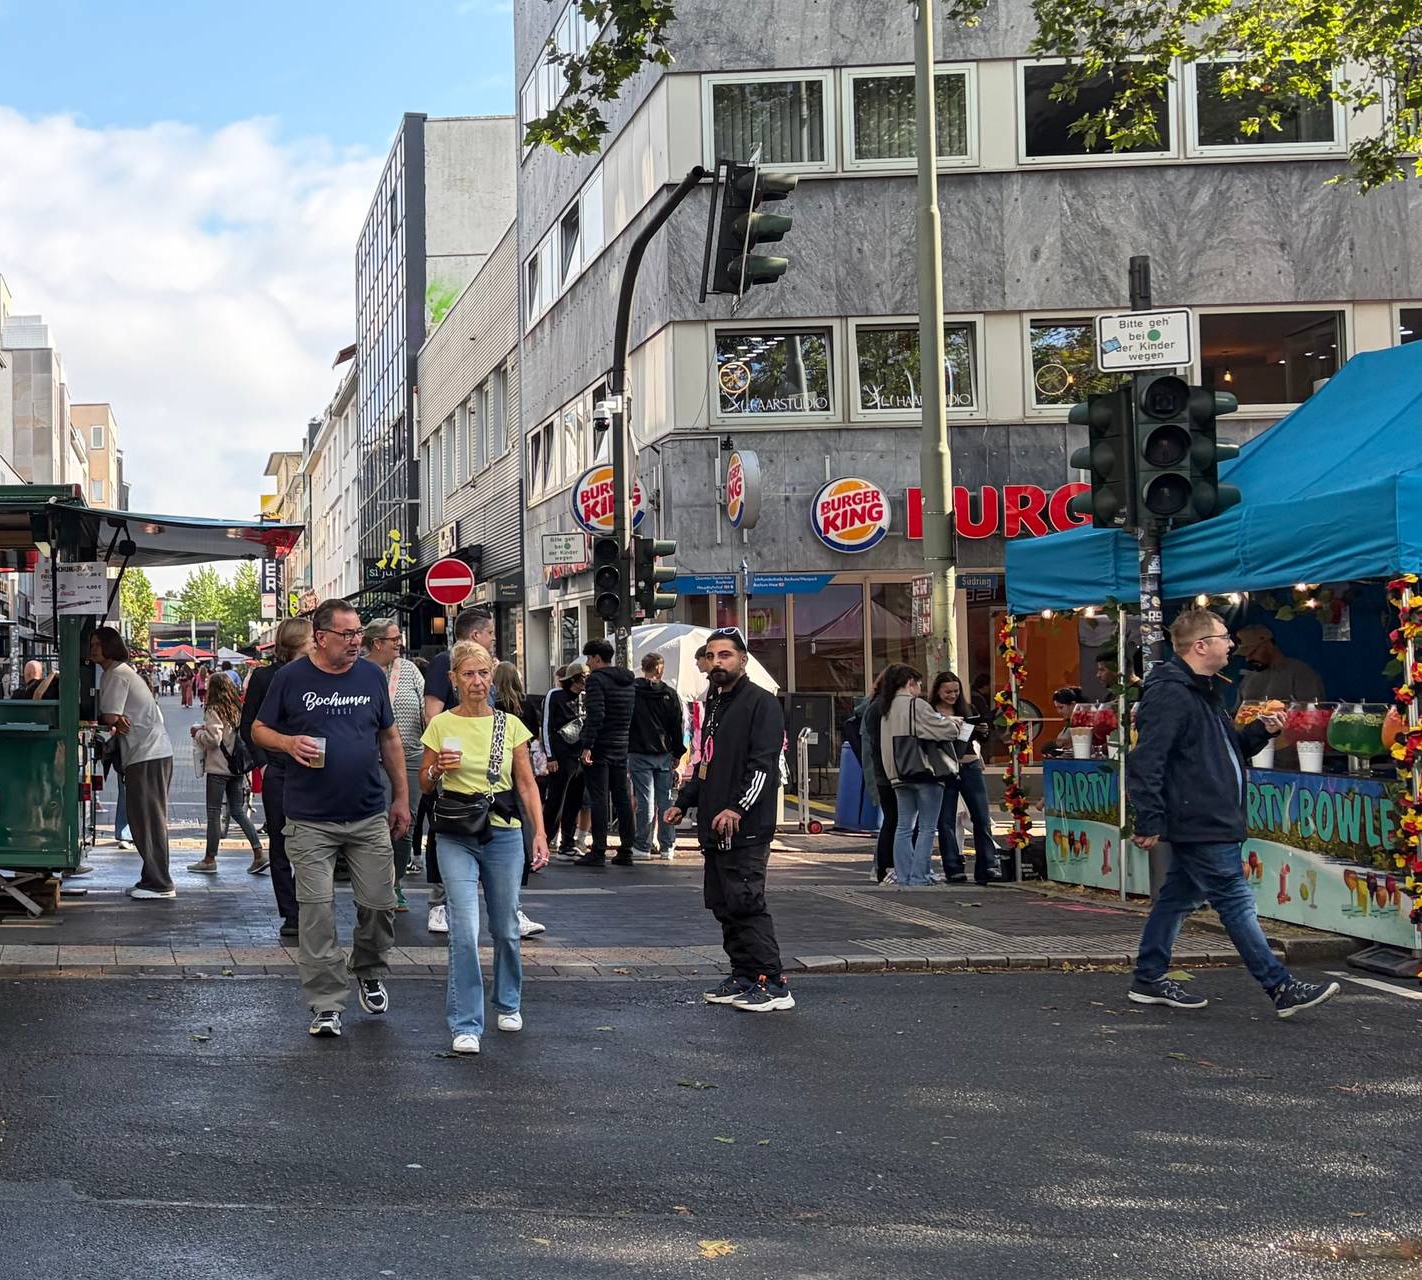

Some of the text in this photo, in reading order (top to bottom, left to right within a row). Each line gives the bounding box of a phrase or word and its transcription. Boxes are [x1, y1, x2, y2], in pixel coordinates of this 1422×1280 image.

[1119, 320, 1144, 329] Bitte
[1128, 333, 1145, 341] bei
[1139, 341, 1175, 351] Kinder
[1128, 352, 1164, 361] wegen
[820, 490, 881, 516] BURGER
[907, 482, 1092, 539] URG
[822, 503, 884, 537] KING
[962, 576, 991, 588] Südring
[302, 691, 371, 711] Bochumer
[1052, 770, 1112, 815] PARTY
[1247, 783, 1396, 850] RTY BOWLE
